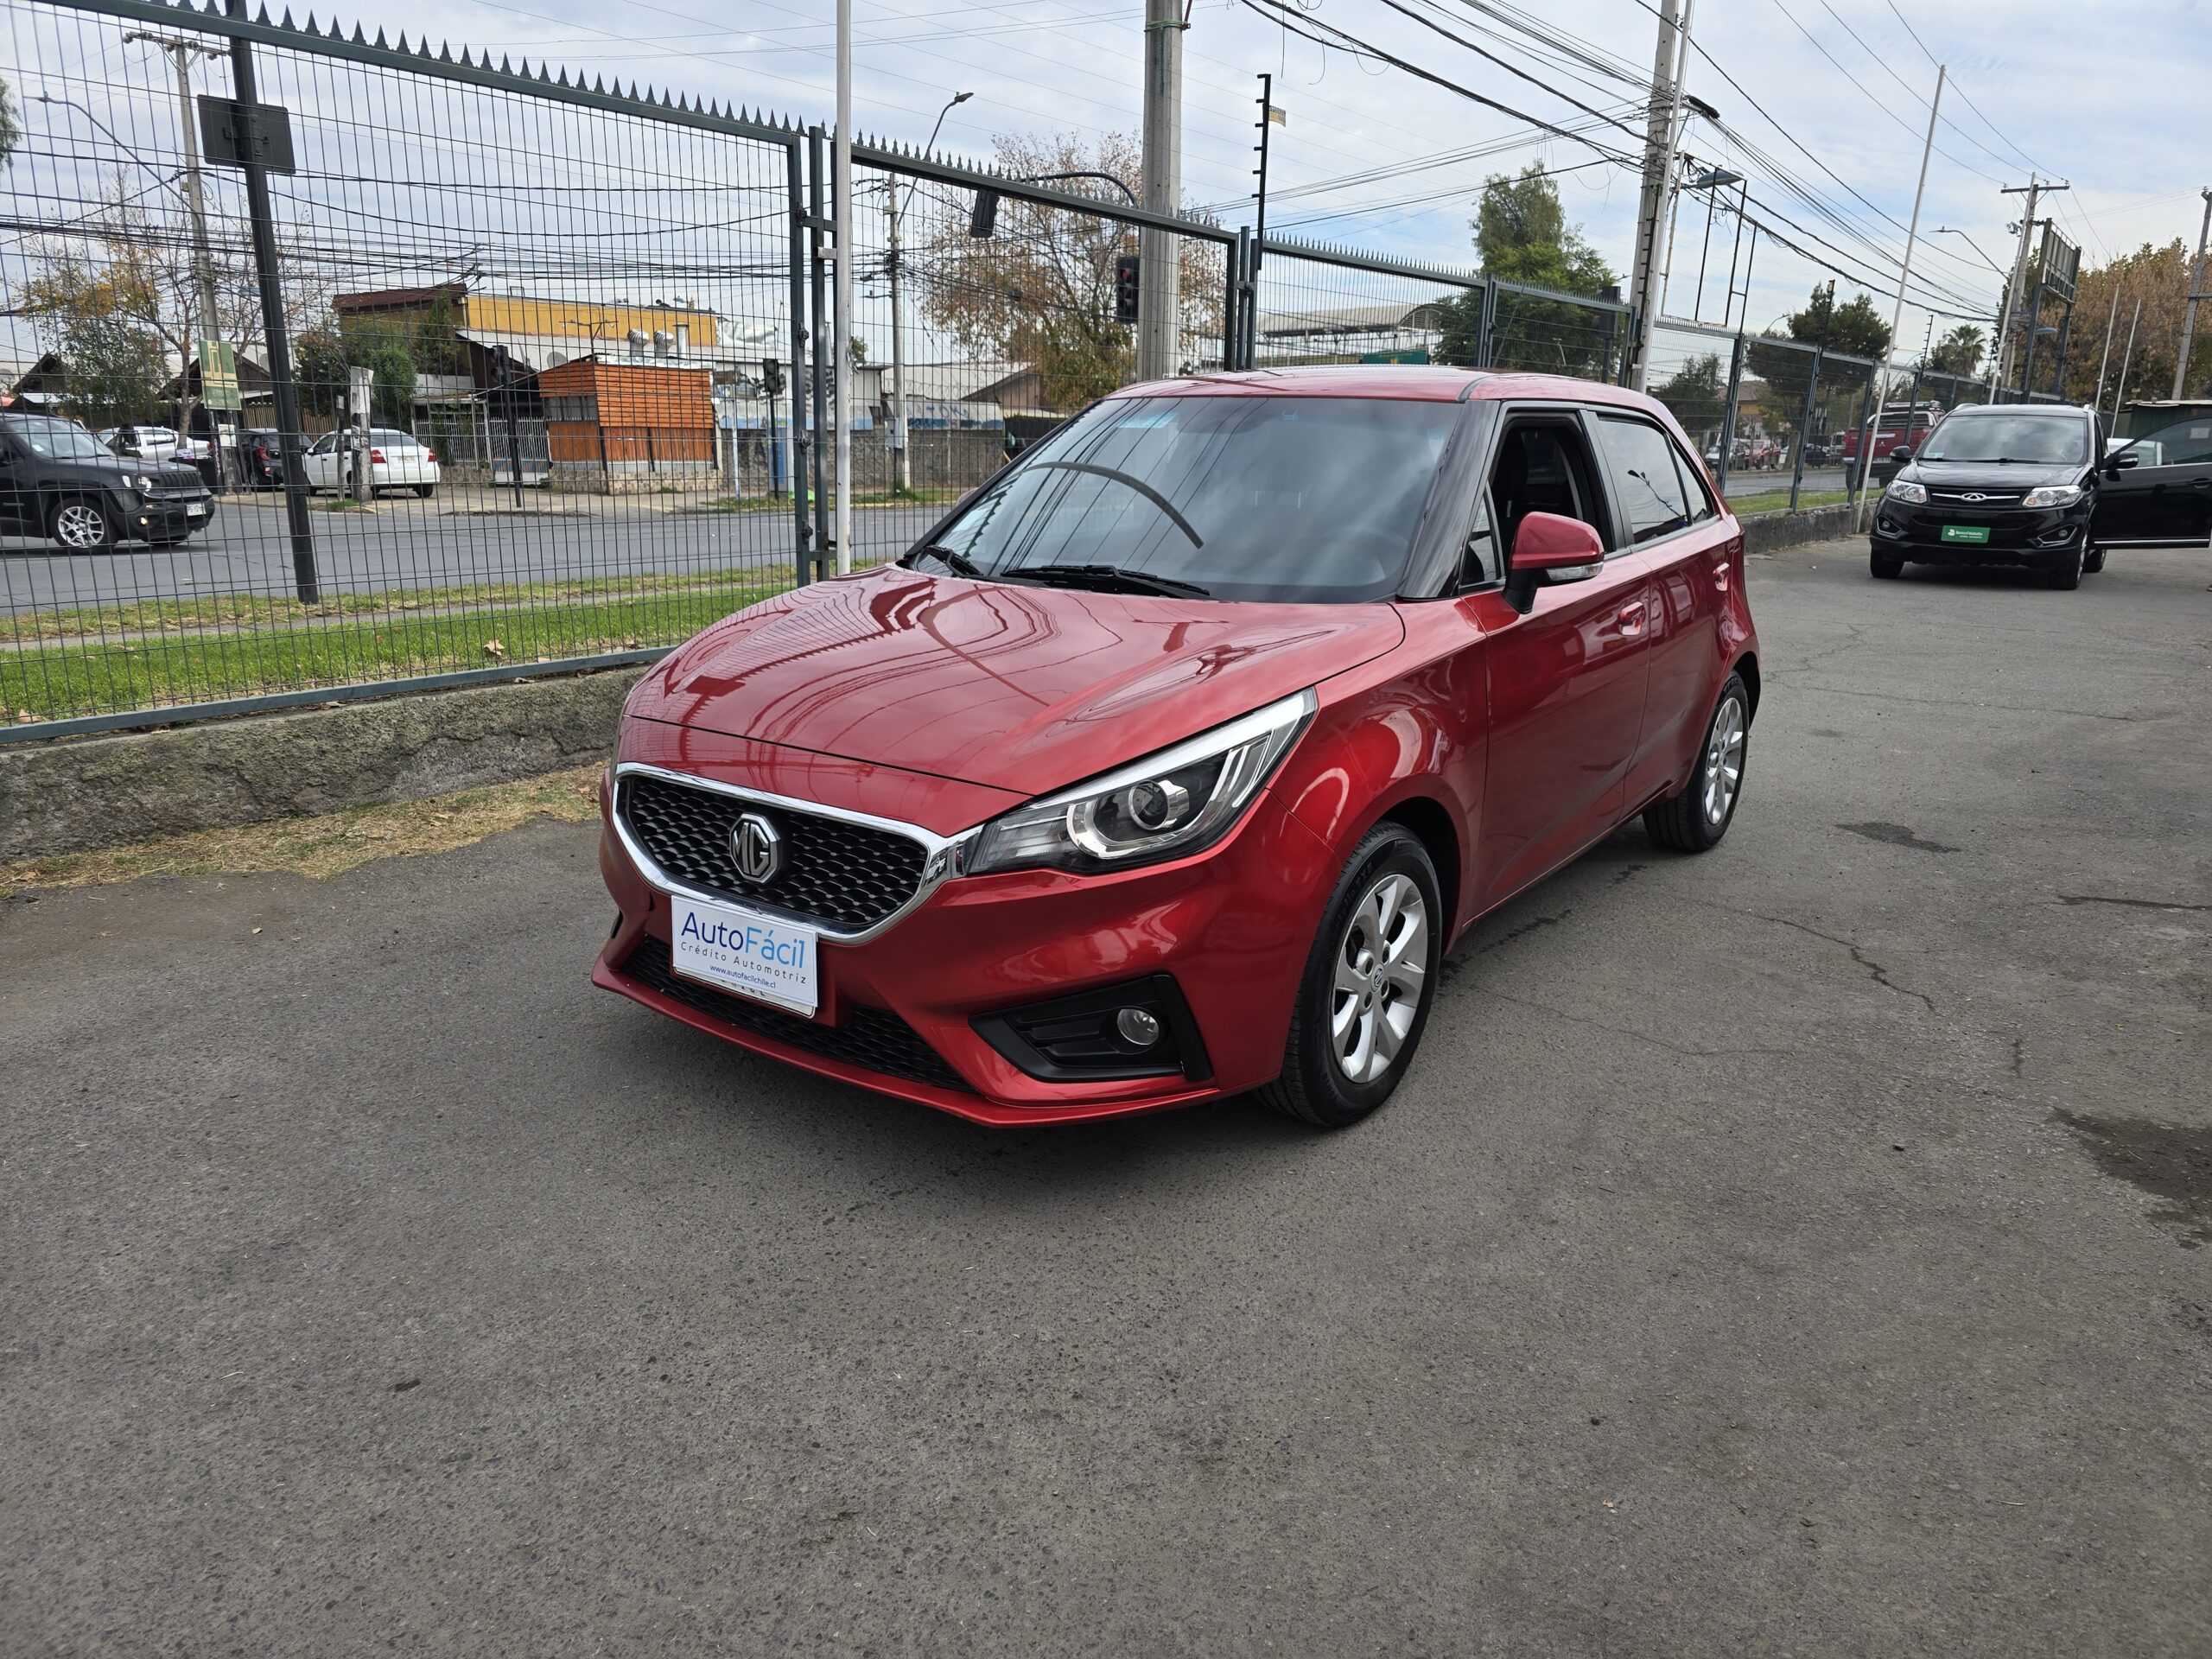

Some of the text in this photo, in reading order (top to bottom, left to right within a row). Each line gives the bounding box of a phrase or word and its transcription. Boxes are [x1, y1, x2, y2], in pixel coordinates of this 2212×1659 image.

[733, 822, 769, 876] MG
[681, 912, 805, 969] AutoFácil
[681, 941, 806, 984] Crédito Automotriz
[709, 964, 776, 988] www.autofacilchile.cl
